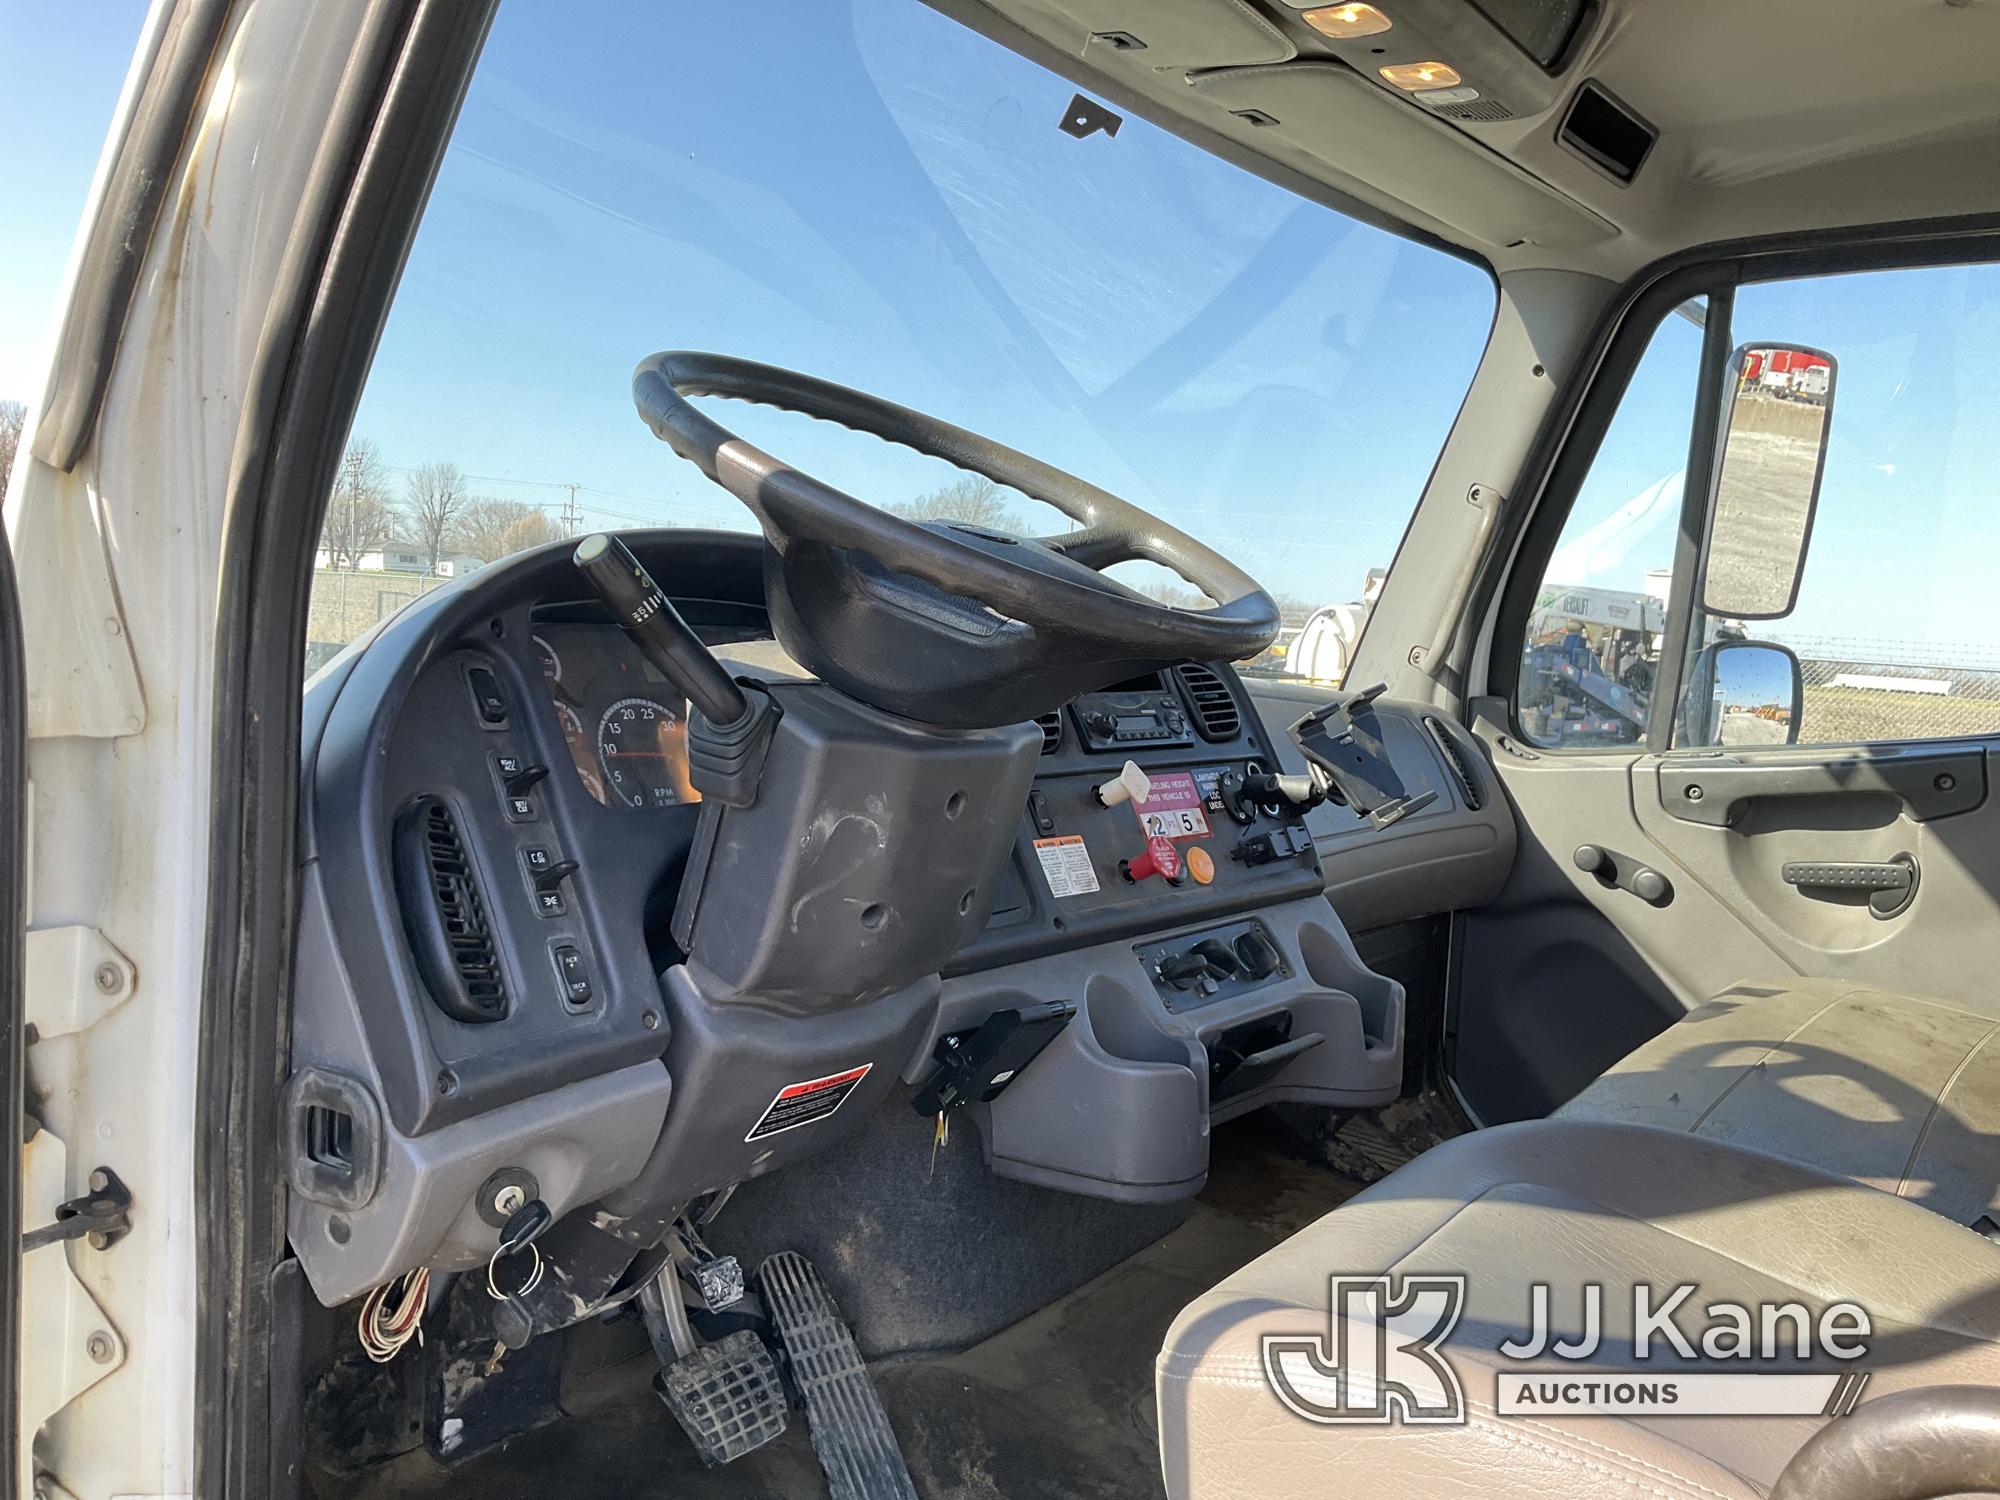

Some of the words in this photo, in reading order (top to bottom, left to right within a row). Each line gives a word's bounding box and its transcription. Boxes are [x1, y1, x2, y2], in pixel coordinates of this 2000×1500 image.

[620, 708, 636, 720] 20
[640, 708, 655, 719] 25
[608, 722, 622, 734] 15
[661, 720, 676, 732] 30
[603, 743, 618, 755] 10
[614, 770, 623, 782] 5
[654, 787, 674, 798] RPM
[633, 794, 643, 807] 0
[1181, 813, 1193, 832] 5
